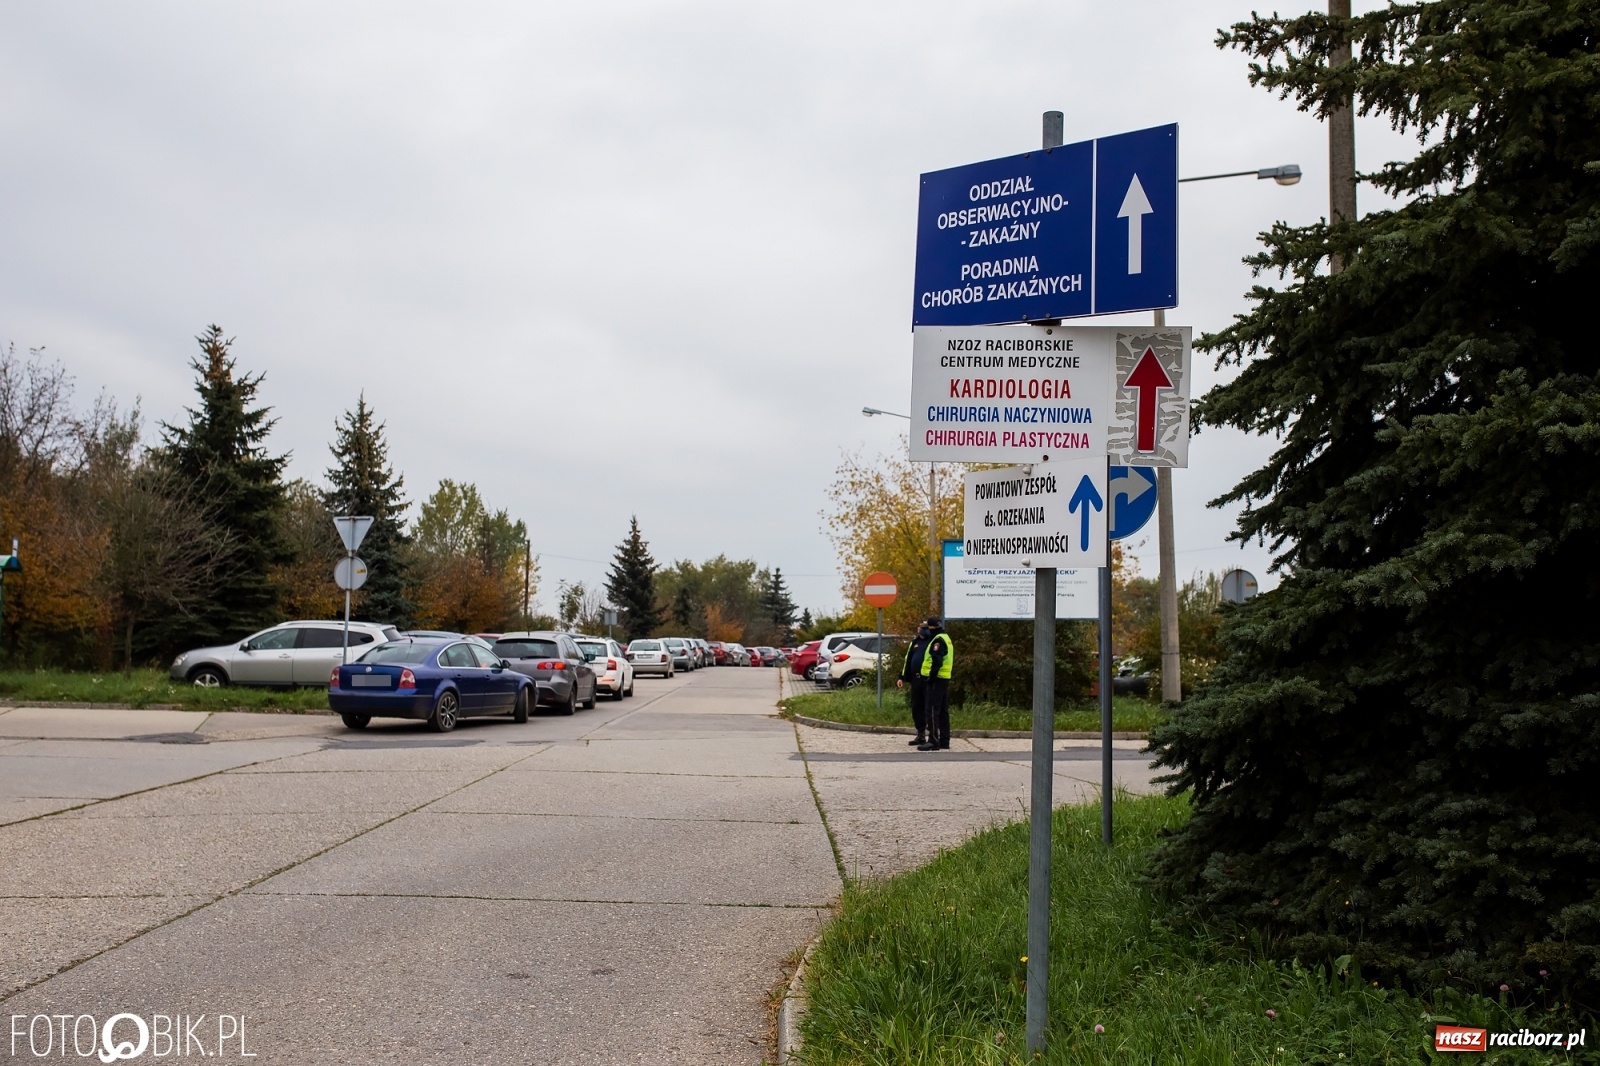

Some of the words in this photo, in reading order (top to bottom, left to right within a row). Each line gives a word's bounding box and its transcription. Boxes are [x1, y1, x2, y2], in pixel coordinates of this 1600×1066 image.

[969, 175, 1035, 202] ODDZIAŁ
[937, 193, 1069, 230] OBSERWACYJNO-
[961, 255, 1039, 281] PORADNIA
[921, 282, 983, 308] CHORÓB
[987, 274, 1082, 302] ZAKAŹNYCH
[947, 339, 981, 351] NZOZ
[985, 339, 1074, 352] RACIBORSKIE
[940, 356, 1004, 368] CENTRUM
[1008, 356, 1080, 369] MEDYCZNE
[949, 379, 1072, 399] KARDIOLOGIA
[927, 405, 1000, 423] CHIRURGIA
[1003, 406, 1093, 424] NACZYNIOWA
[925, 429, 998, 447] CHIRURGIA
[1002, 431, 1090, 449] PLASTYCZNA
[975, 478, 1024, 500] POWIATOWY
[1025, 472, 1057, 495] ZESPÓŁ
[984, 510, 996, 527] ds.
[997, 506, 1045, 527] ORZEKANIA
[966, 539, 972, 556] O
[973, 531, 1069, 556] NIEPEŁNOSPRAWNOŚCI
